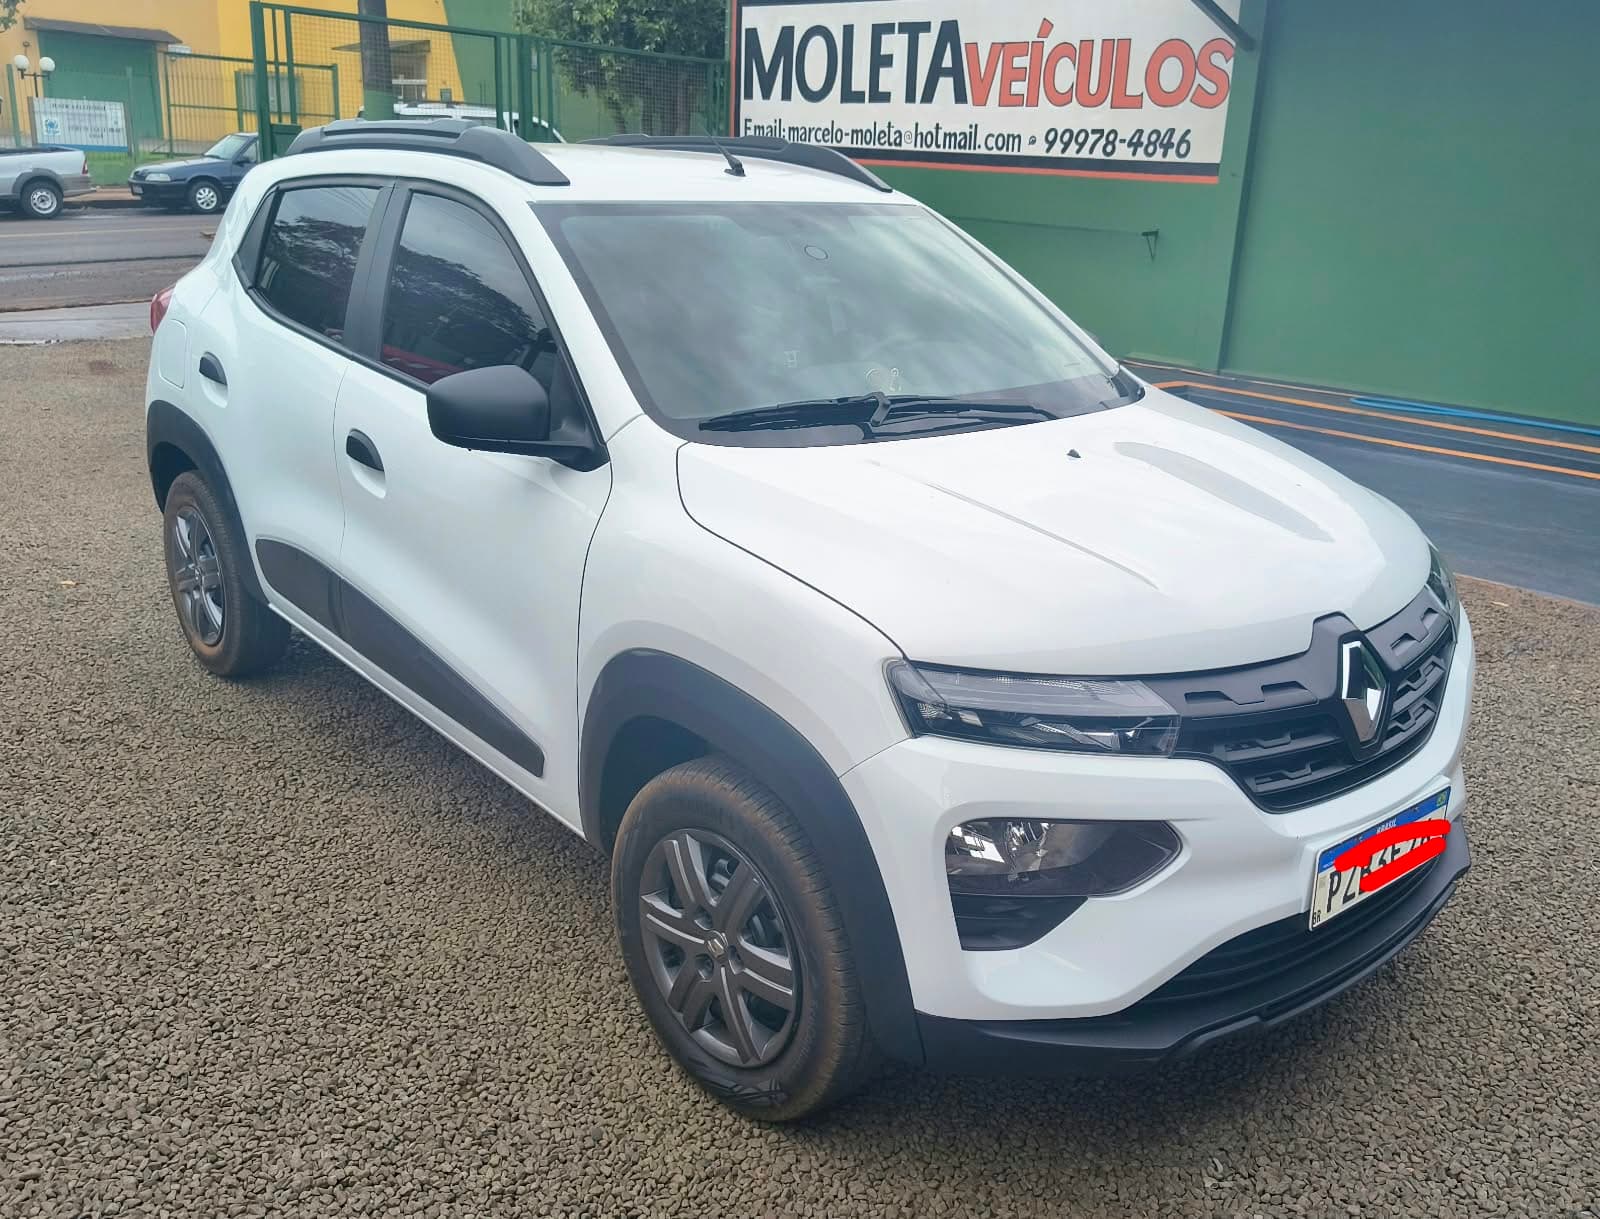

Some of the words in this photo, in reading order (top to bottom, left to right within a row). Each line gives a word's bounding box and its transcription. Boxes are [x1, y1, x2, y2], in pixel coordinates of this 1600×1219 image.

[743, 19, 968, 105] MOLETA
[964, 17, 1235, 109] VEÍCULOS
[1044, 127, 1192, 159] 99978-4846
